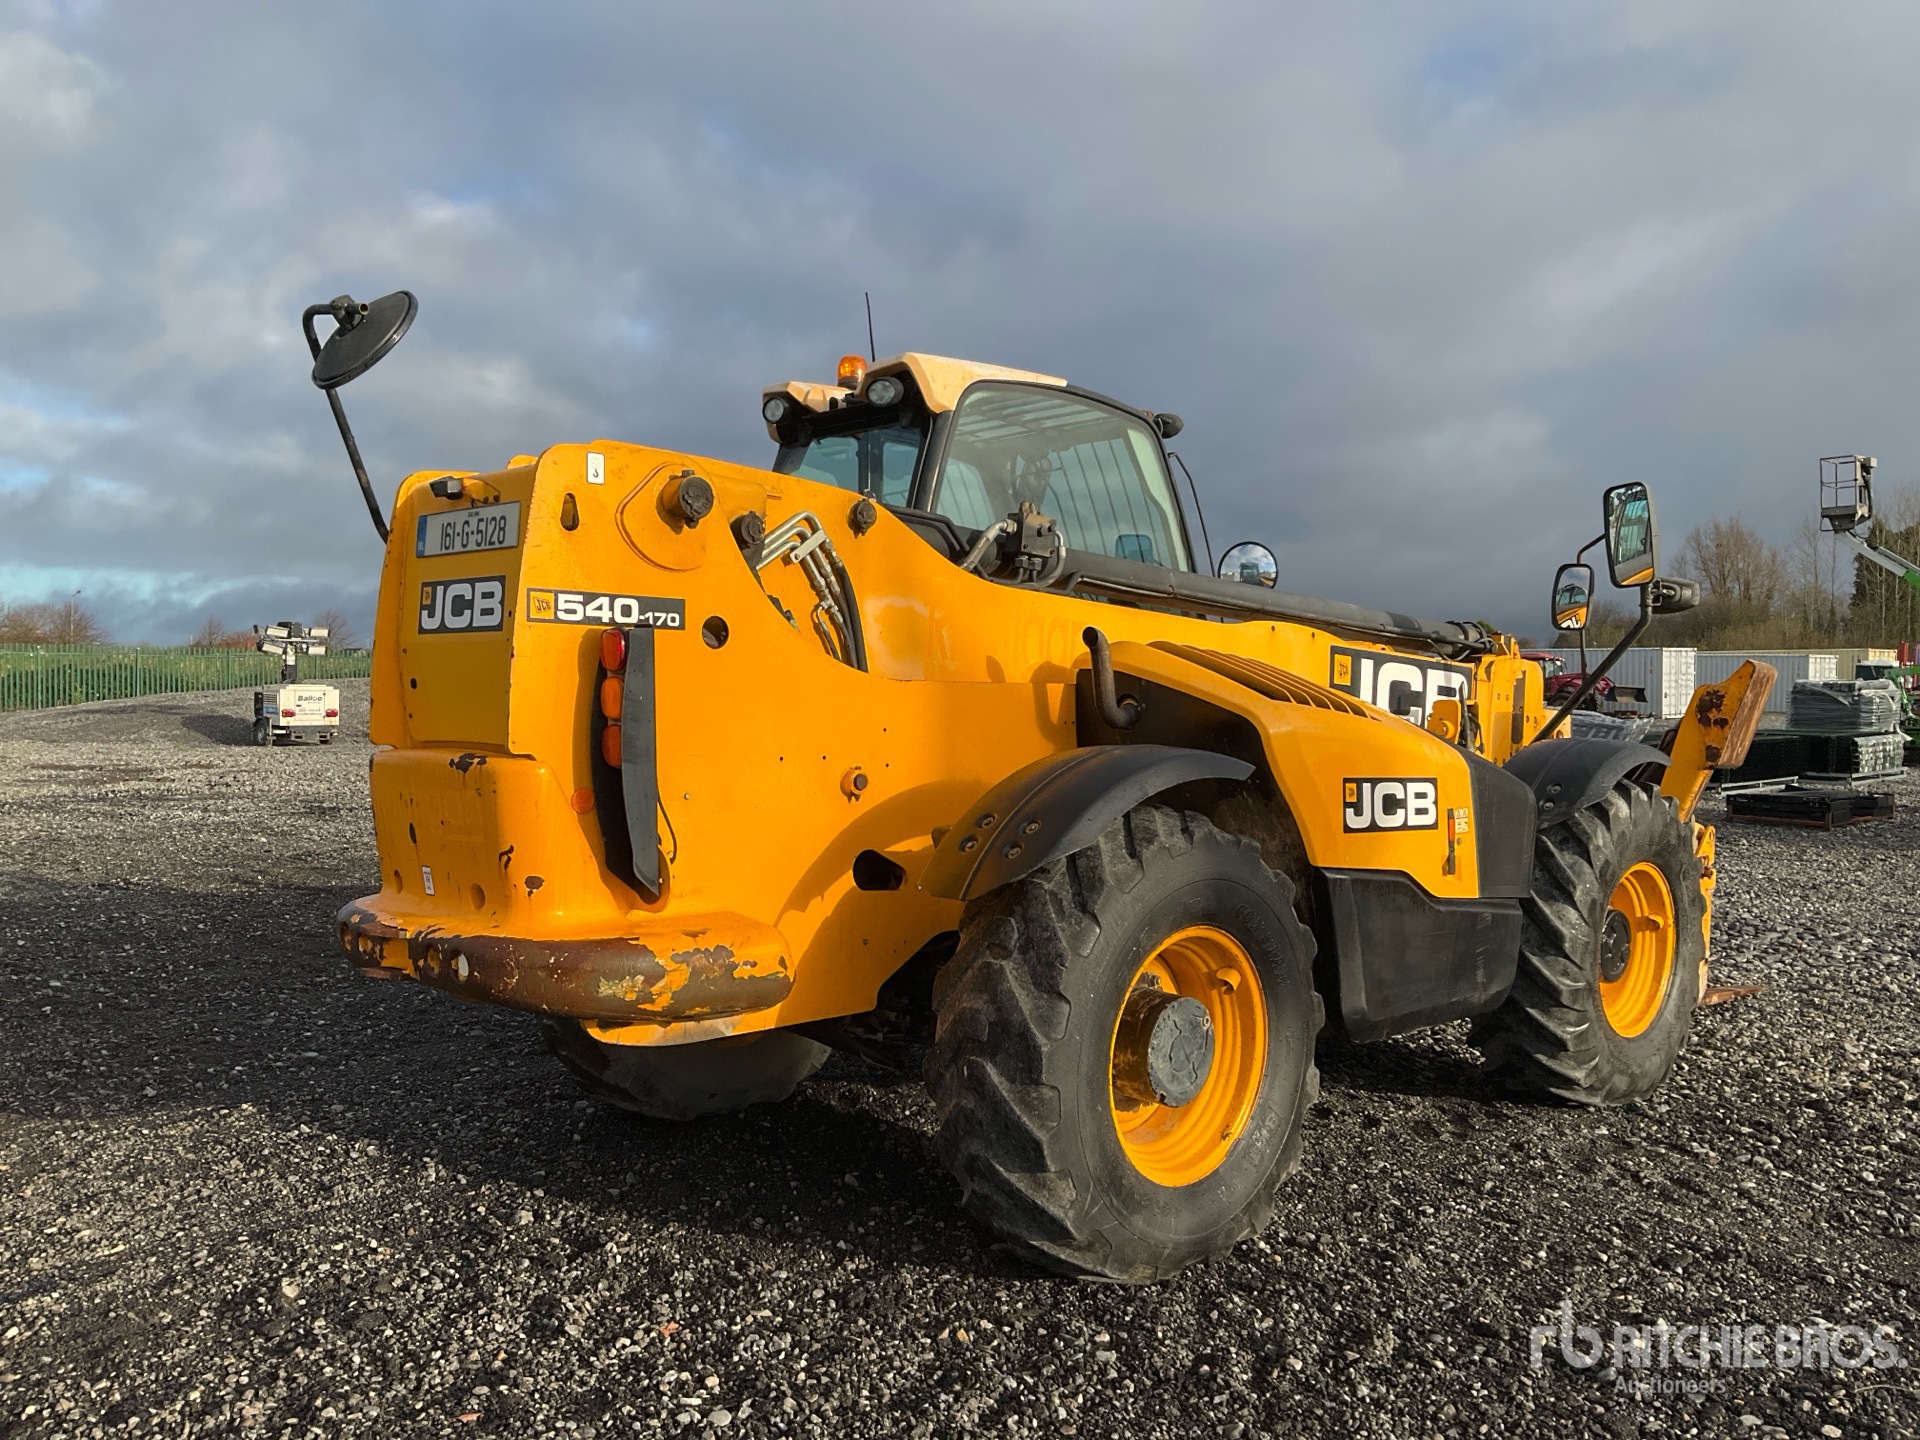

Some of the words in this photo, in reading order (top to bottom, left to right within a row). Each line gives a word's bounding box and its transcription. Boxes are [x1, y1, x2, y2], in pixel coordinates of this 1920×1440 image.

[439, 515, 507, 551] 161-G-5128
[421, 580, 503, 630] JCB
[535, 597, 551, 613] JCB
[1345, 781, 1437, 829] JCB
